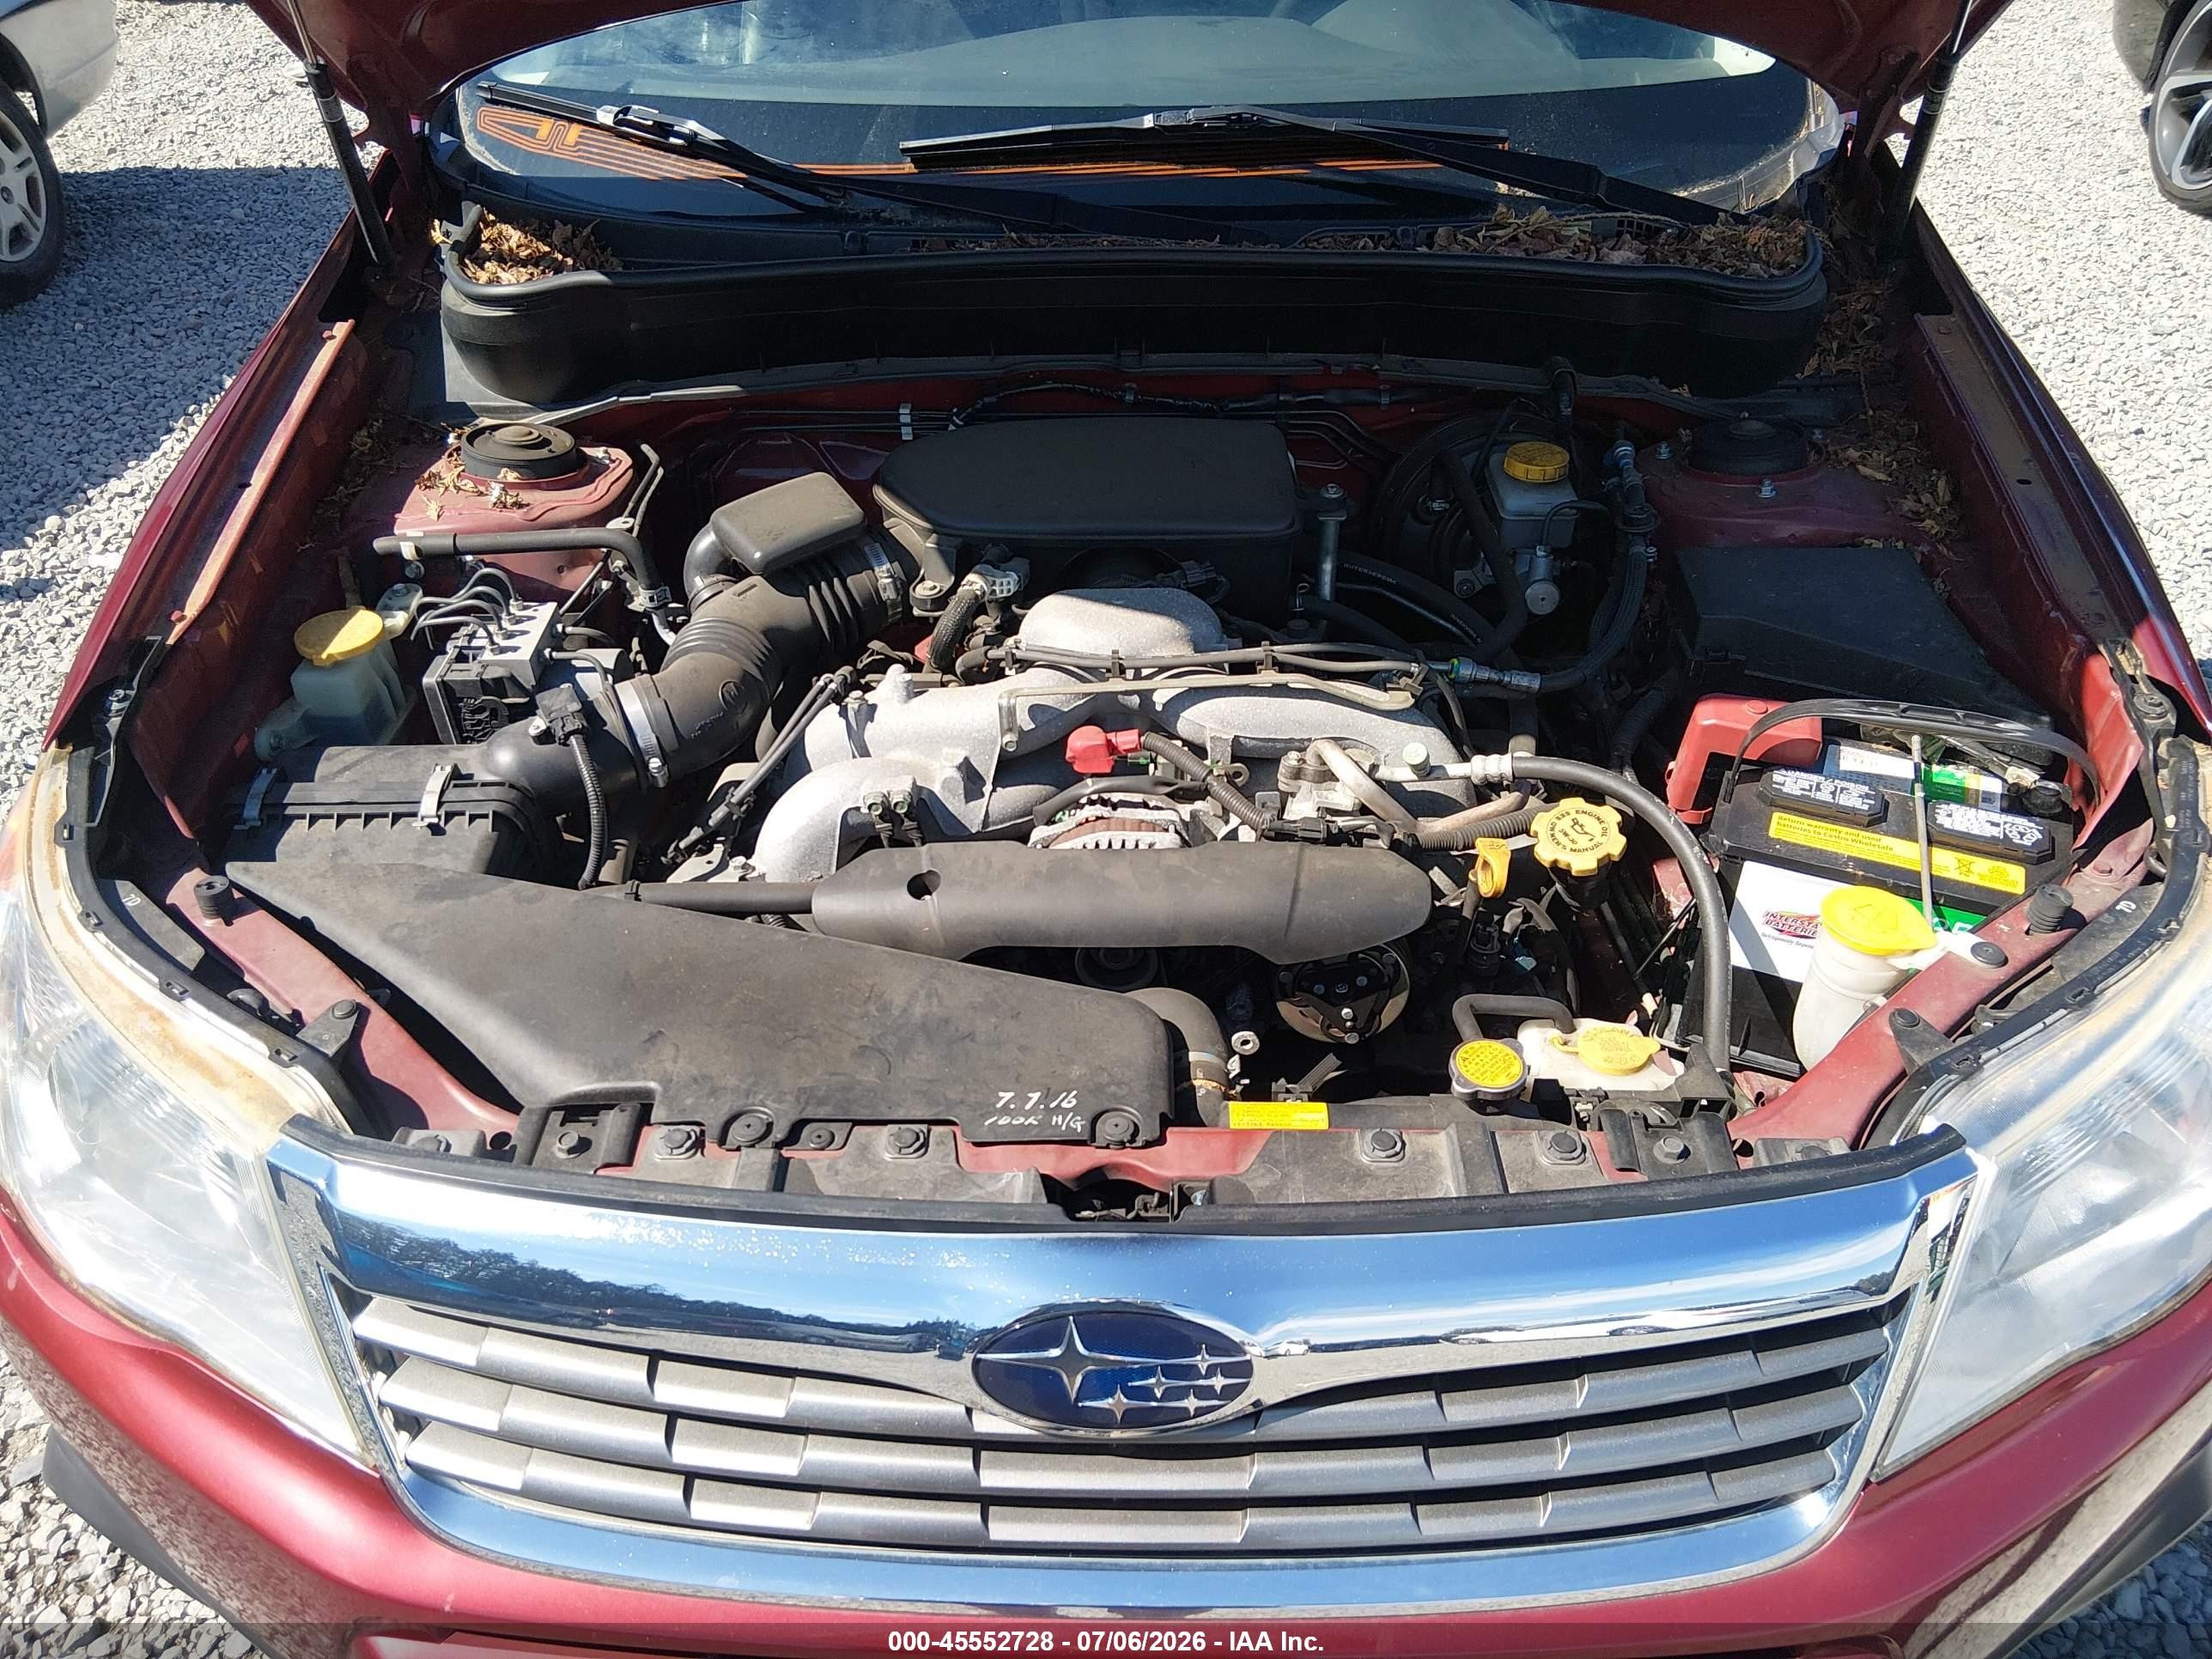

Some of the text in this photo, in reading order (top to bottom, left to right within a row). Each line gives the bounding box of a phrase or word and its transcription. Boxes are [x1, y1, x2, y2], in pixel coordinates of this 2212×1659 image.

[1575, 810, 1605, 825] ENGINE
[1776, 821, 1812, 834] batteries
[1850, 837, 1893, 851] Wholesale
[1778, 815, 1882, 842] Return warranty and used
[1570, 842, 1603, 853] MANUAL
[1764, 910, 1822, 930] INTERSTA
[1764, 919, 1820, 937] BATTERIE
